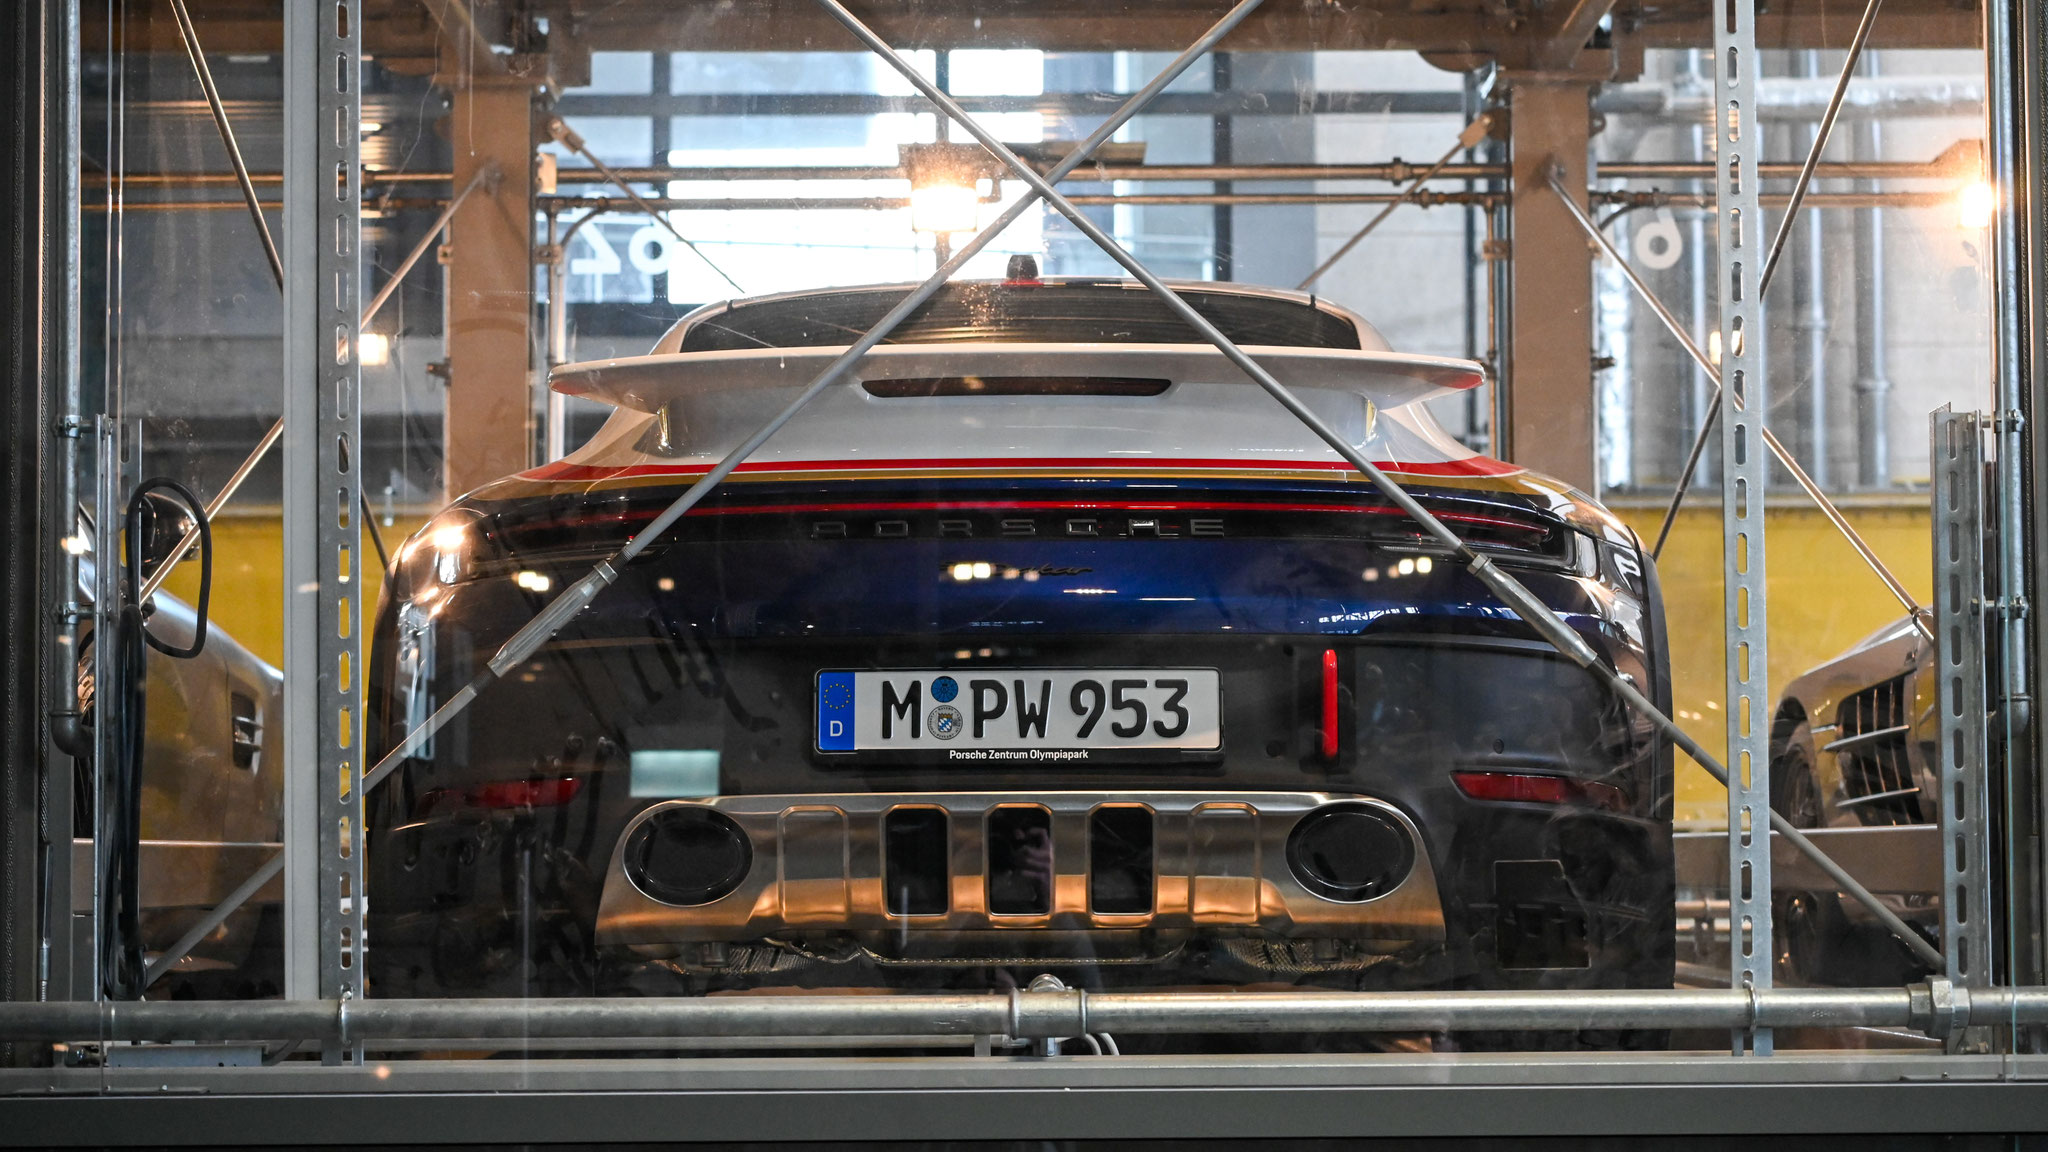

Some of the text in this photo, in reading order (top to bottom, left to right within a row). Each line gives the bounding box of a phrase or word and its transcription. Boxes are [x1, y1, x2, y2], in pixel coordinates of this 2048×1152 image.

[811, 518, 1224, 538] PORSCHE
[881, 680, 922, 740] M
[970, 679, 1054, 739] PW
[1070, 679, 1190, 739] 953
[829, 720, 844, 738] D
[949, 749, 1089, 761] Porsche Zentrum Olympiapark
